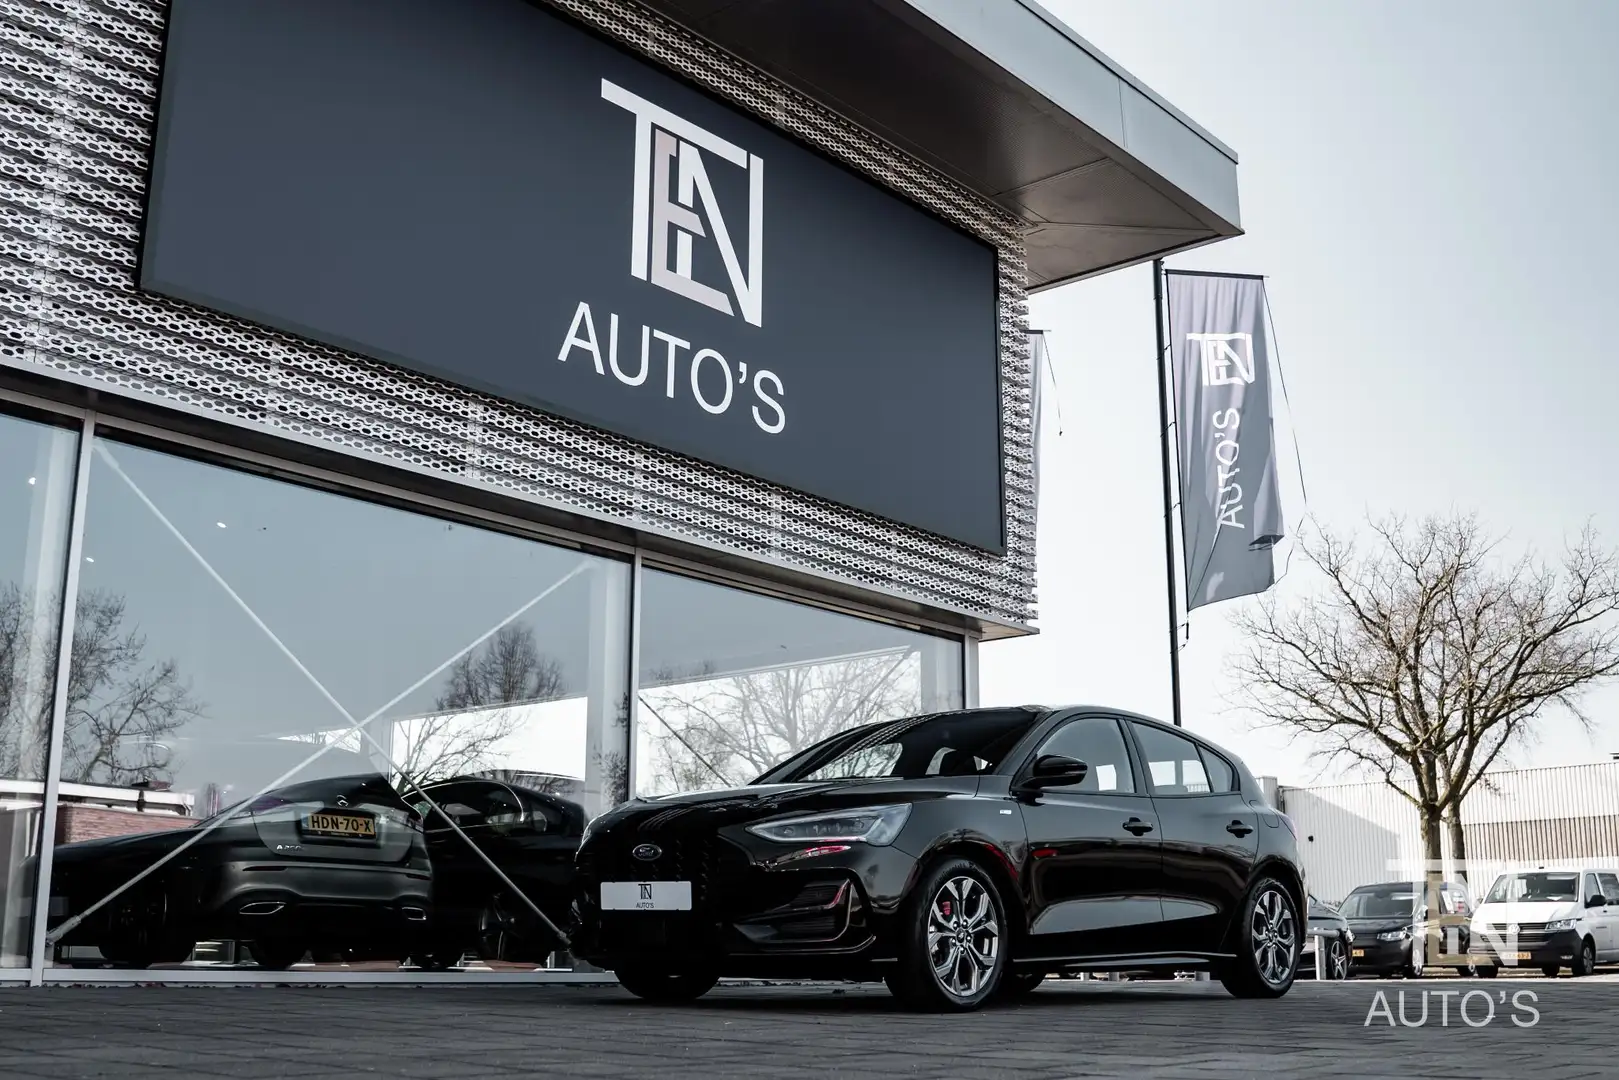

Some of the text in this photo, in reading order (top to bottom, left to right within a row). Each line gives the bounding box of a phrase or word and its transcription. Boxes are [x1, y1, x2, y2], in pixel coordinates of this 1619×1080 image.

[557, 301, 786, 434] AUTO'S
[1212, 407, 1245, 529] AUTO'S
[311, 815, 371, 832] HDN-70-X
